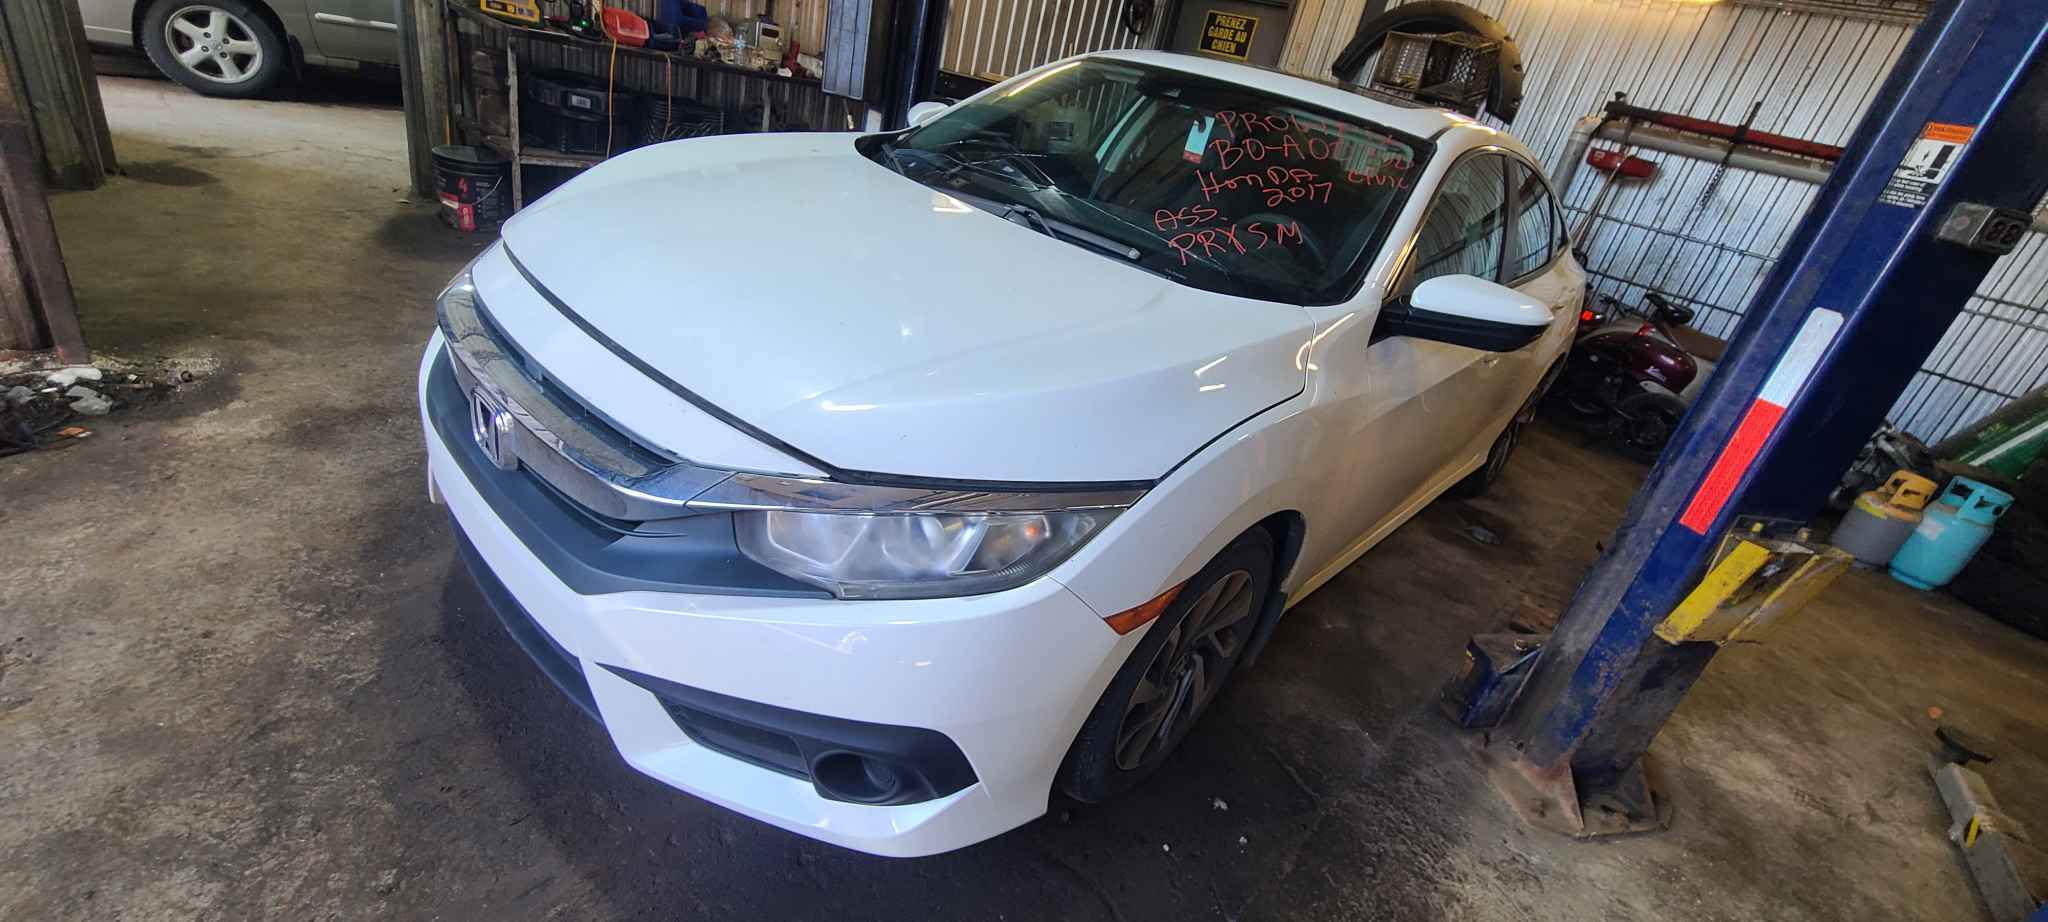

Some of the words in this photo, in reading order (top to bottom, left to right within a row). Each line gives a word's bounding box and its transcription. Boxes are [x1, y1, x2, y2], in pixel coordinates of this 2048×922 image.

[1215, 15, 1247, 30] PRENEZ
[1208, 26, 1235, 41] GARDE
[1235, 30, 1248, 43] AU
[1211, 39, 1237, 53] CHIEN
[1262, 181, 1333, 208] 2017
